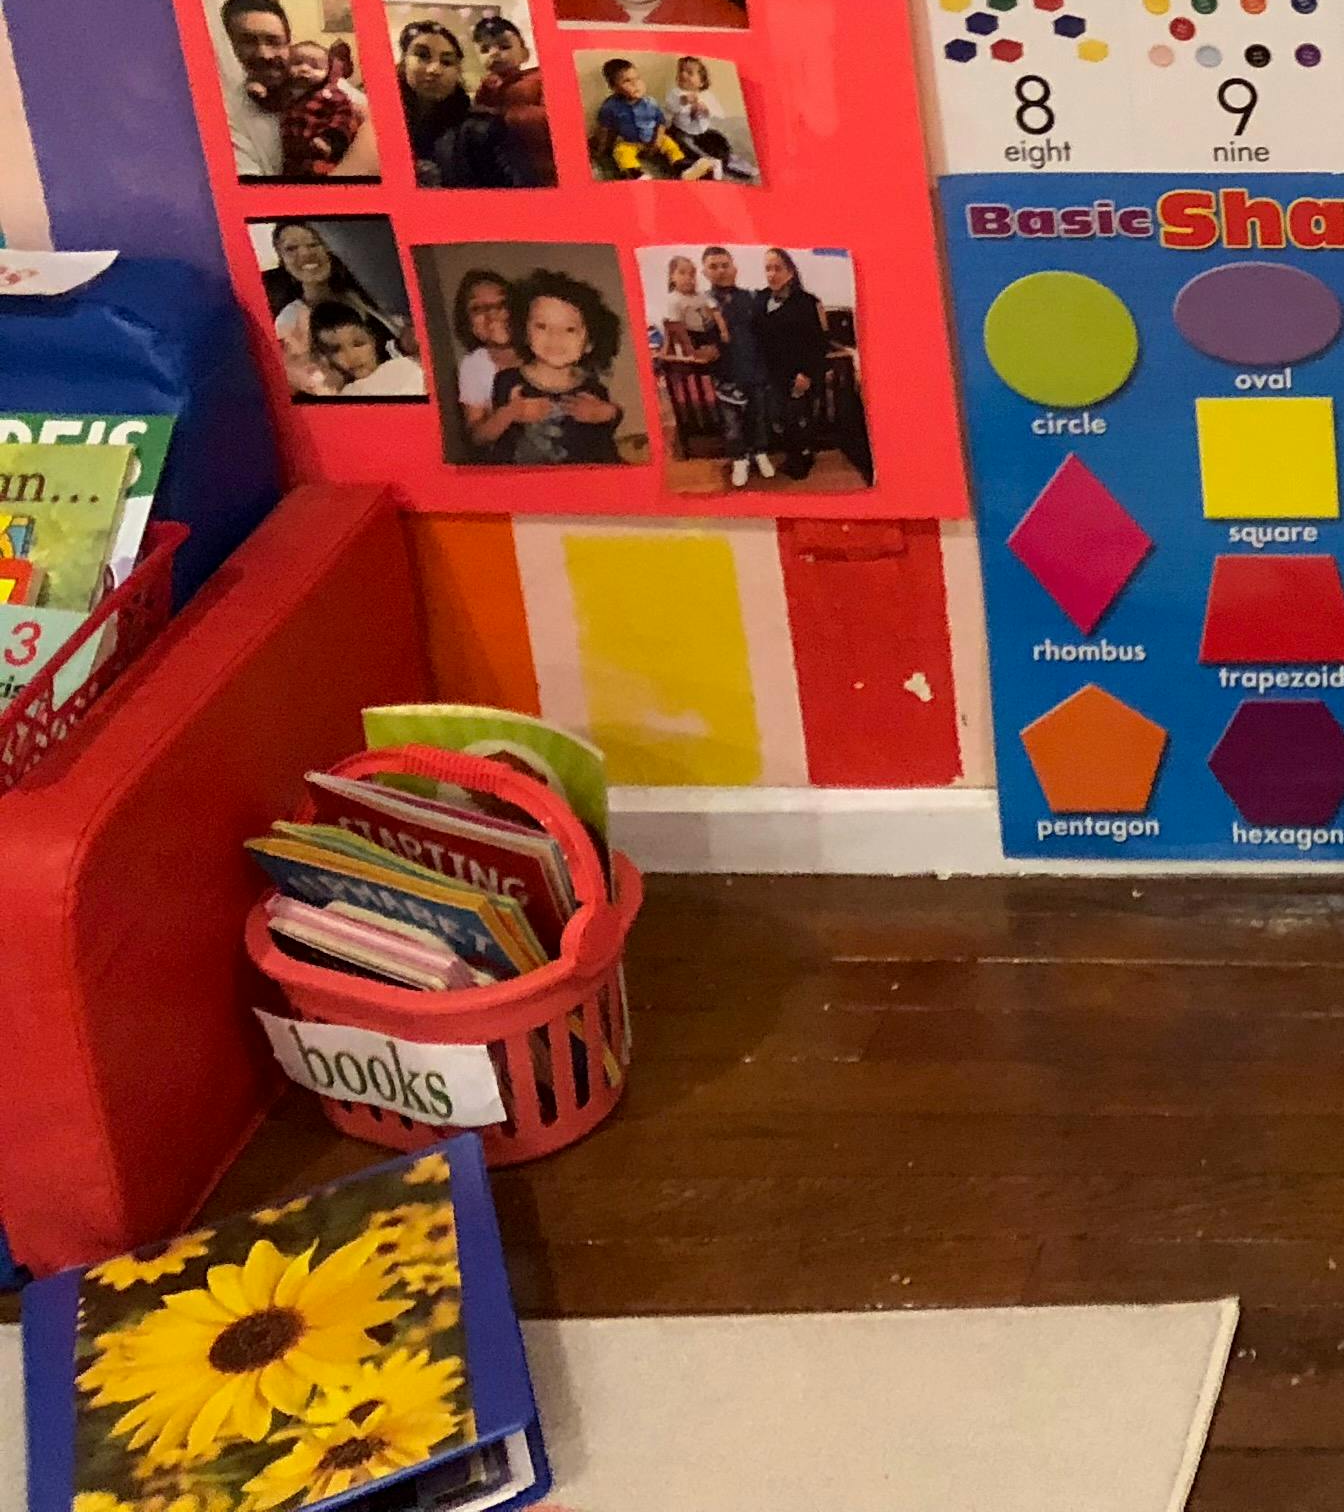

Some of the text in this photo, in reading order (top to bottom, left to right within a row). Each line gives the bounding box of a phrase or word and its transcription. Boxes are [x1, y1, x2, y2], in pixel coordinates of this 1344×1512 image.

[1015, 75, 1055, 135] 8
[1218, 77, 1258, 136] 9
[1004, 140, 1072, 168] eight
[1213, 141, 1271, 163] nine
[966, 201, 1154, 240] Basic
[1234, 368, 1292, 391] oval
[1031, 412, 1107, 436] circle
[1228, 522, 1318, 549] square
[4, 620, 42, 667] 3
[1032, 638, 1146, 663] rhombus
[1037, 814, 1159, 842] pentagon
[1232, 822, 1344, 849] hexagon
[288, 1024, 455, 1121] books
